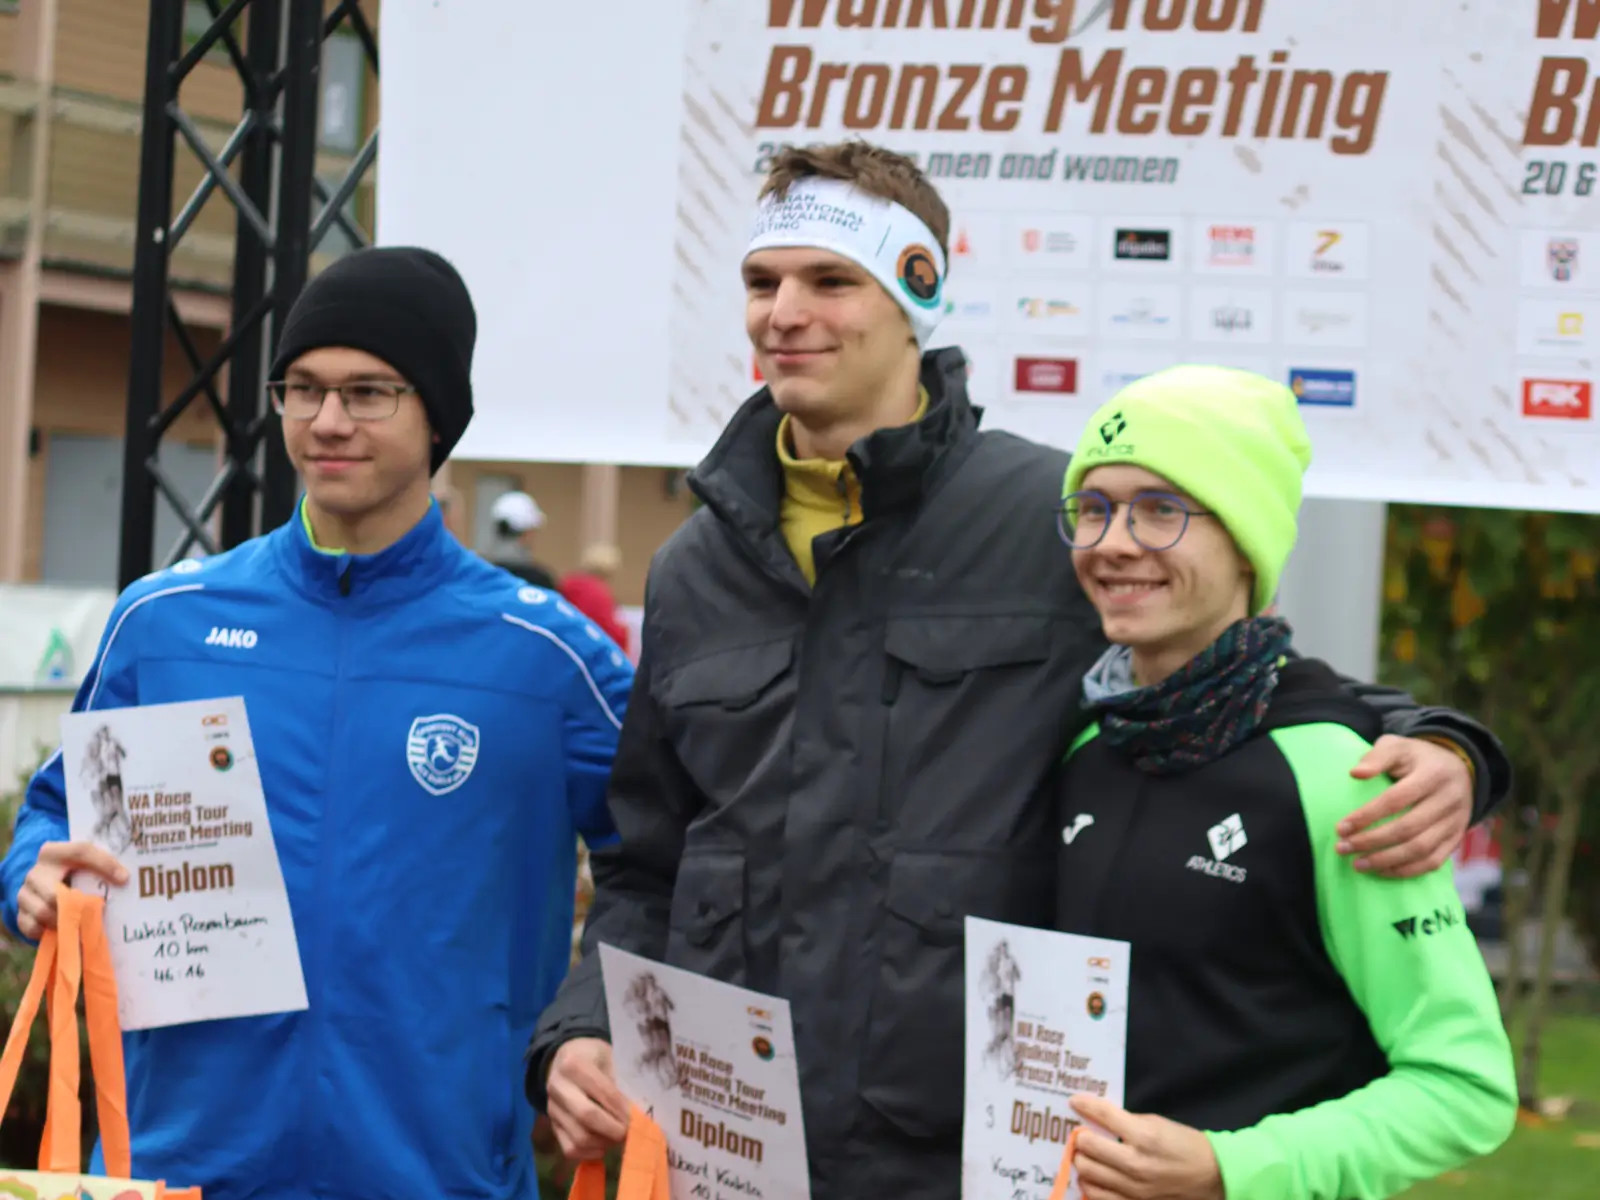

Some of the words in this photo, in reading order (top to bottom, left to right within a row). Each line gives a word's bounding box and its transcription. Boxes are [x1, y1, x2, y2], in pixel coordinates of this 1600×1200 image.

[756, 45, 1028, 132] Bronze
[1044, 47, 1389, 155] Meeting
[928, 150, 990, 178] men
[999, 146, 1059, 181] and
[1063, 152, 1179, 184] women
[1522, 160, 1567, 196] 20
[1574, 161, 1598, 196] &
[205, 627, 258, 649] JAKO
[129, 793, 150, 810] WA
[154, 791, 191, 807] Race
[131, 809, 191, 828] Walking
[196, 805, 229, 821] Tour
[190, 821, 253, 839] Meeting
[139, 861, 234, 901] Diplom
[1186, 854, 1247, 883] ATHLETICS
[154, 941, 180, 958] 10
[736, 1079, 766, 1100] Tour
[729, 1094, 786, 1125] Meeting
[681, 1108, 763, 1163] Diplom
